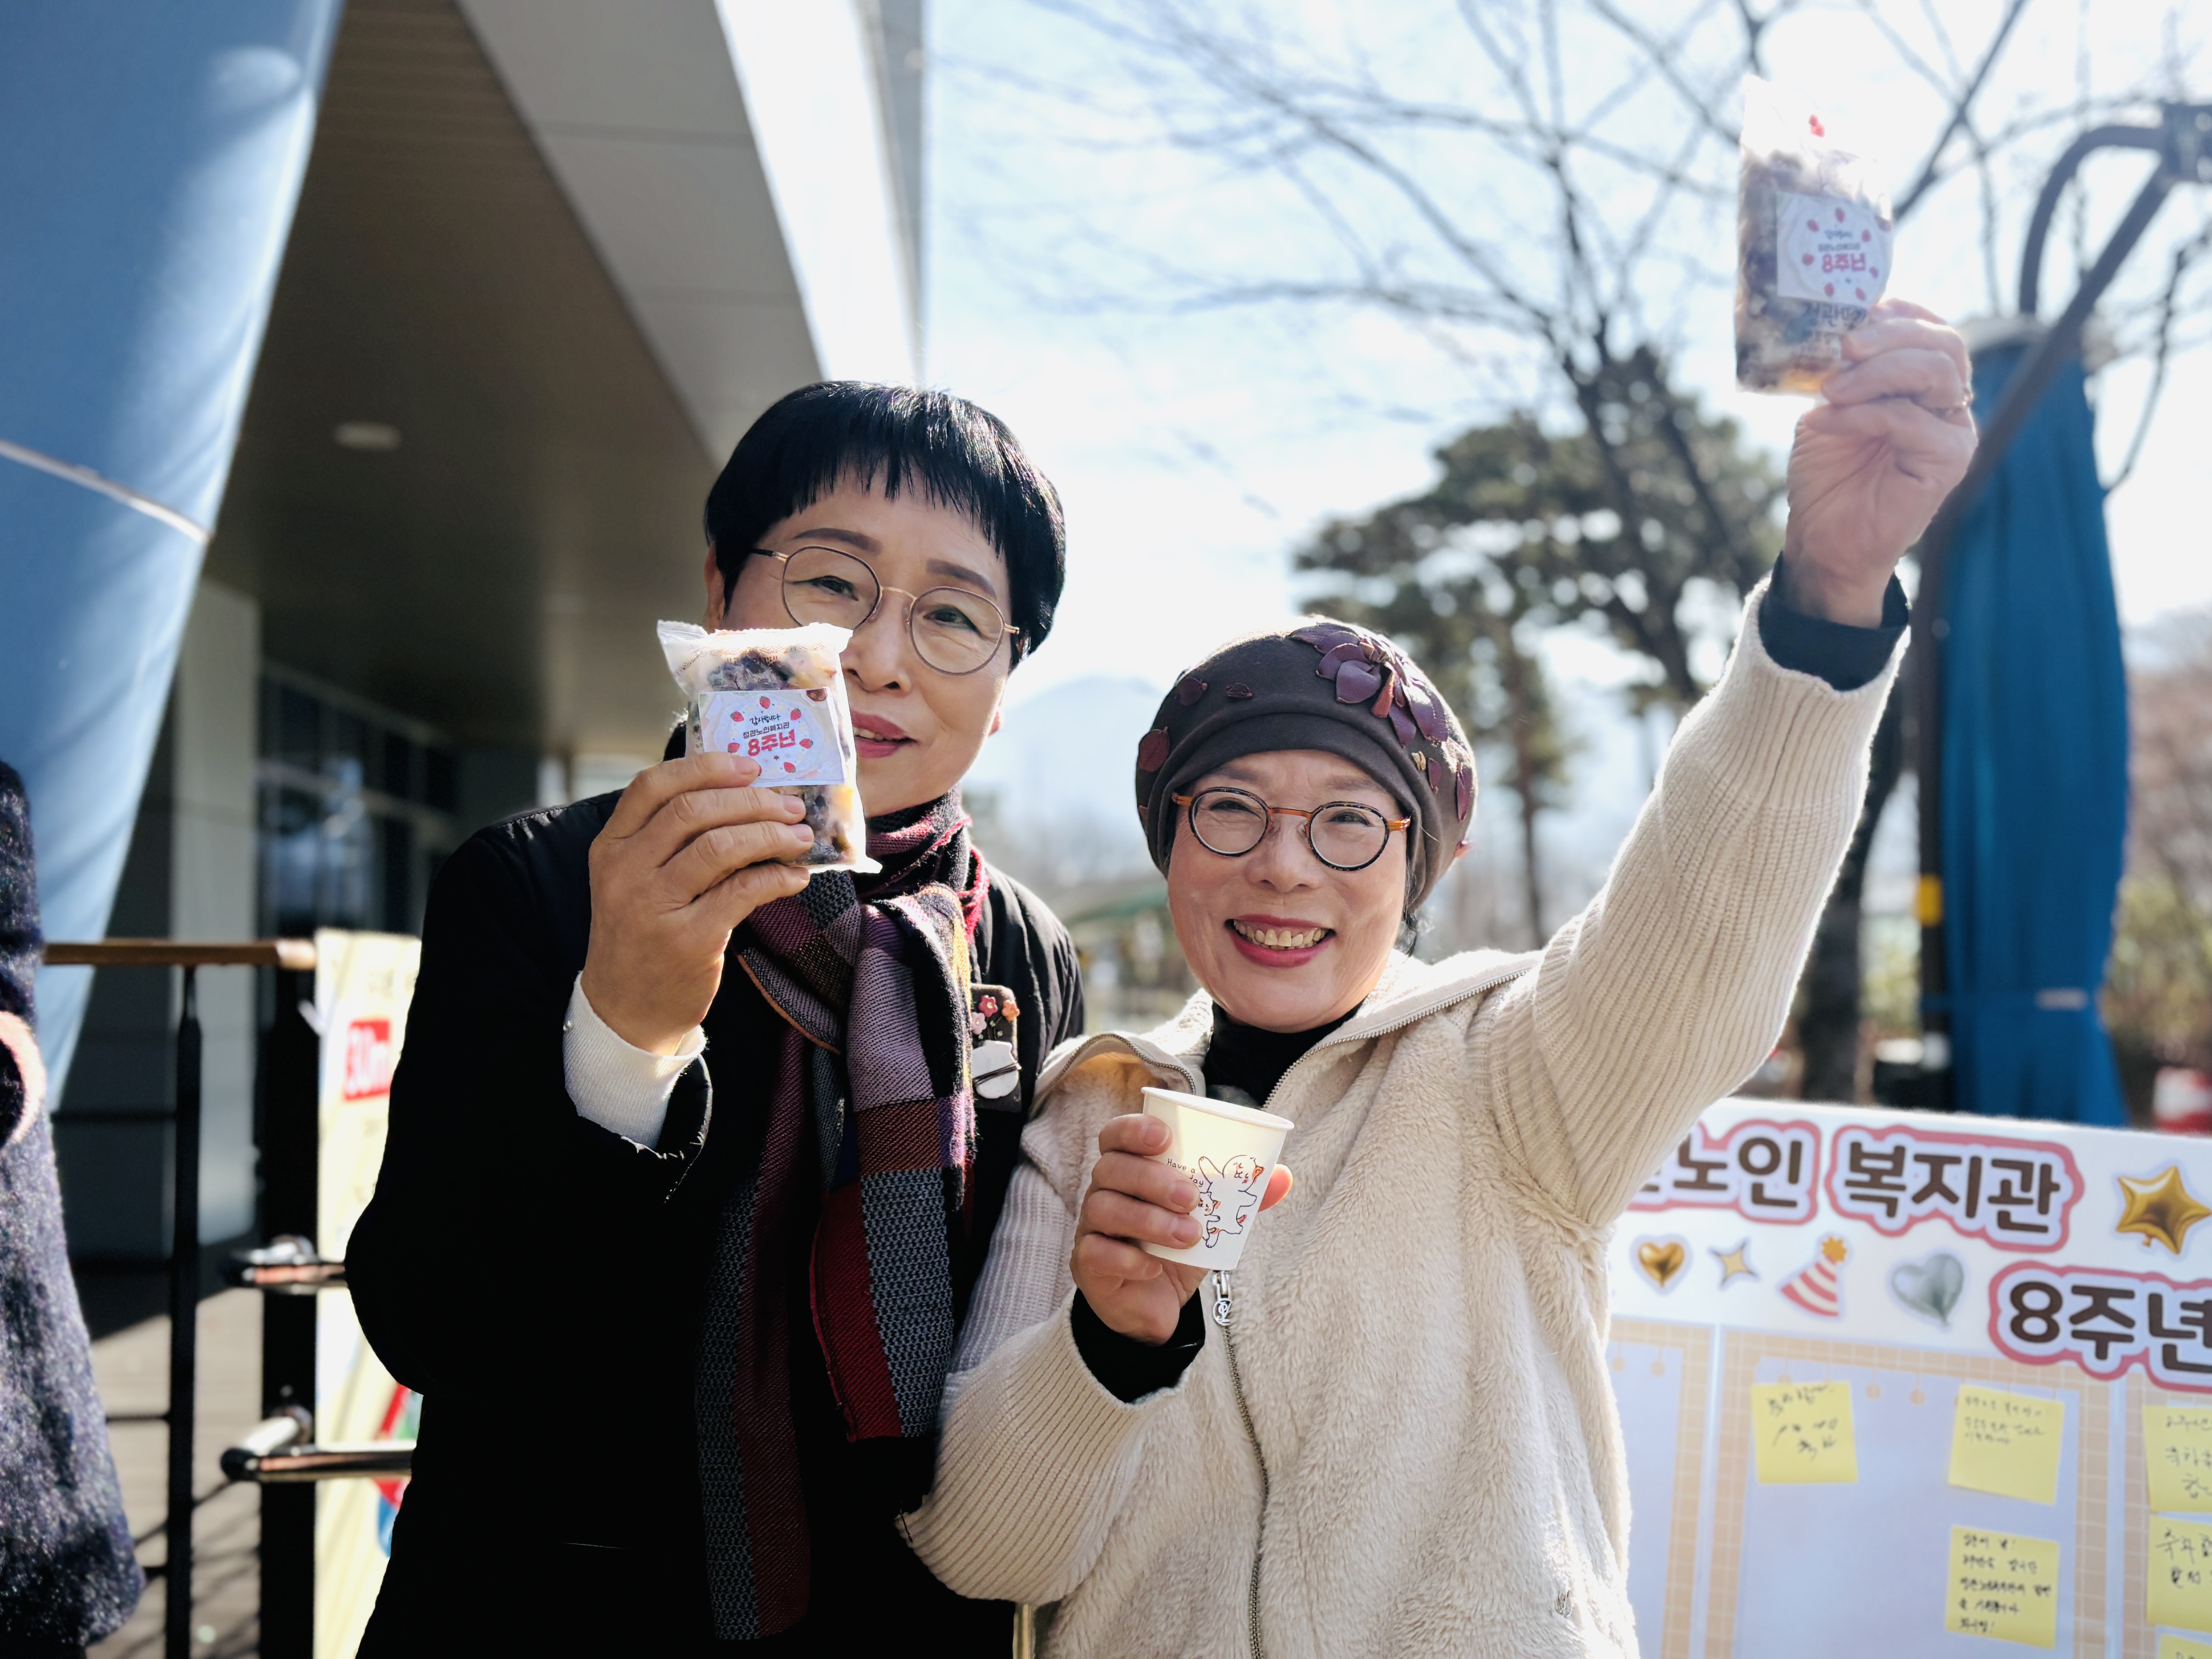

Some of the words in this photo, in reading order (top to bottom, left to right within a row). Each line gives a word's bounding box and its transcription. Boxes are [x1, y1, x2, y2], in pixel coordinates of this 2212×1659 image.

[1822, 253, 1865, 273] 8주년
[749, 714, 781, 726] 감사합니다
[748, 729, 796, 757] 8주년
[1167, 1158, 1187, 1171] Have
[1641, 1134, 1803, 1207] 노인
[1845, 1141, 2061, 1233] 복지관
[2010, 1280, 2212, 1374] 8주년
